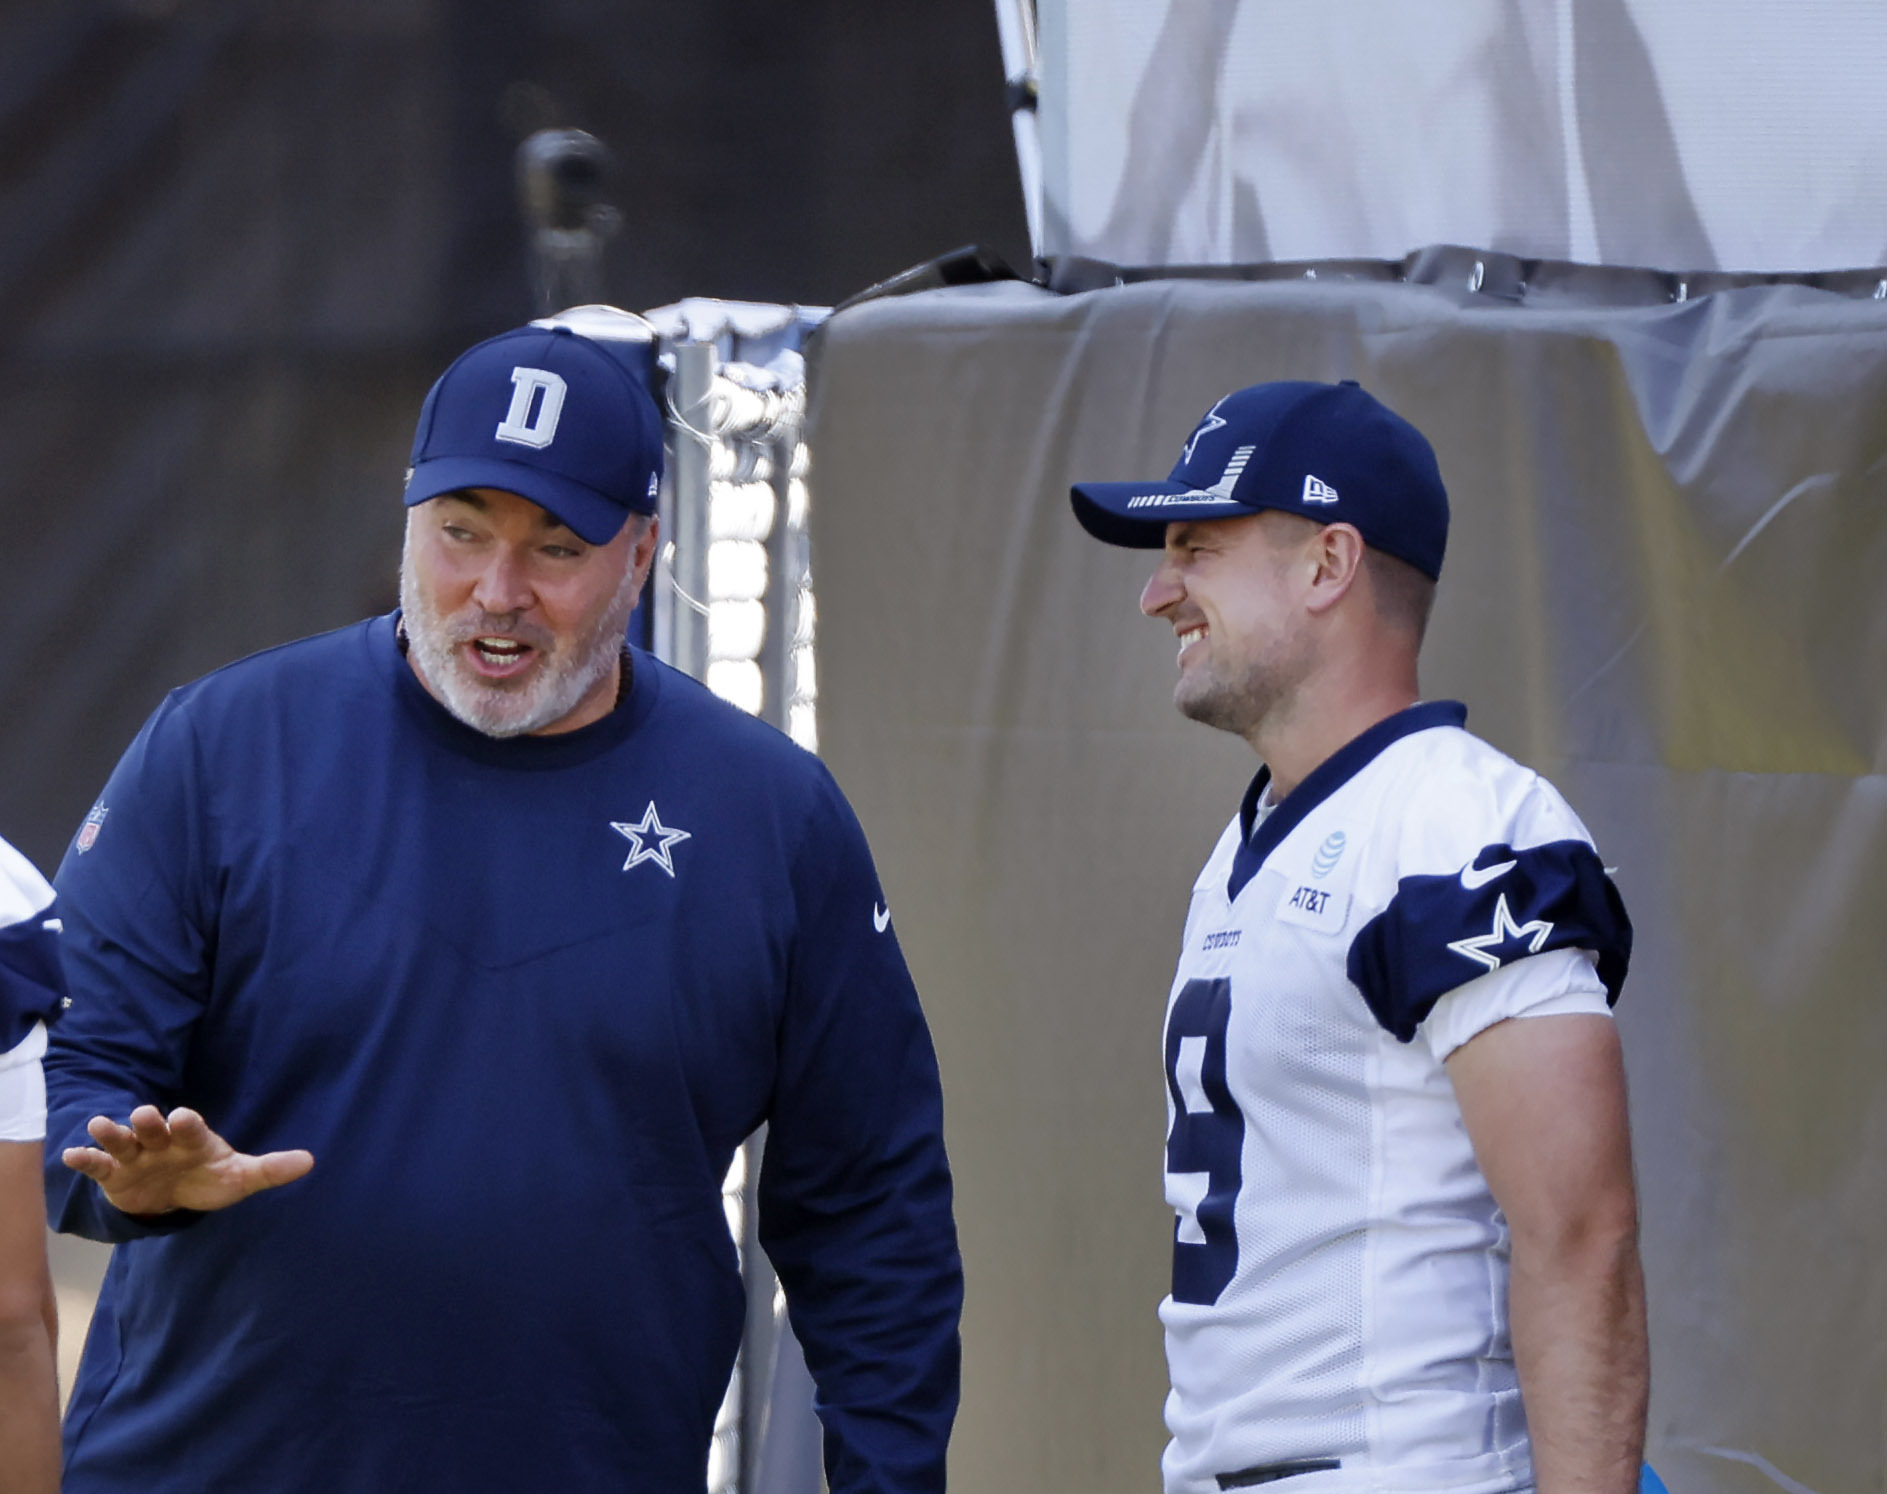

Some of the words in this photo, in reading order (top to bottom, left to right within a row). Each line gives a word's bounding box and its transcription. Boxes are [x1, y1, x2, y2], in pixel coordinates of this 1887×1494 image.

[495, 366, 568, 450] D
[1289, 886, 1331, 915] AT&T
[1165, 976, 1246, 1307] 9
